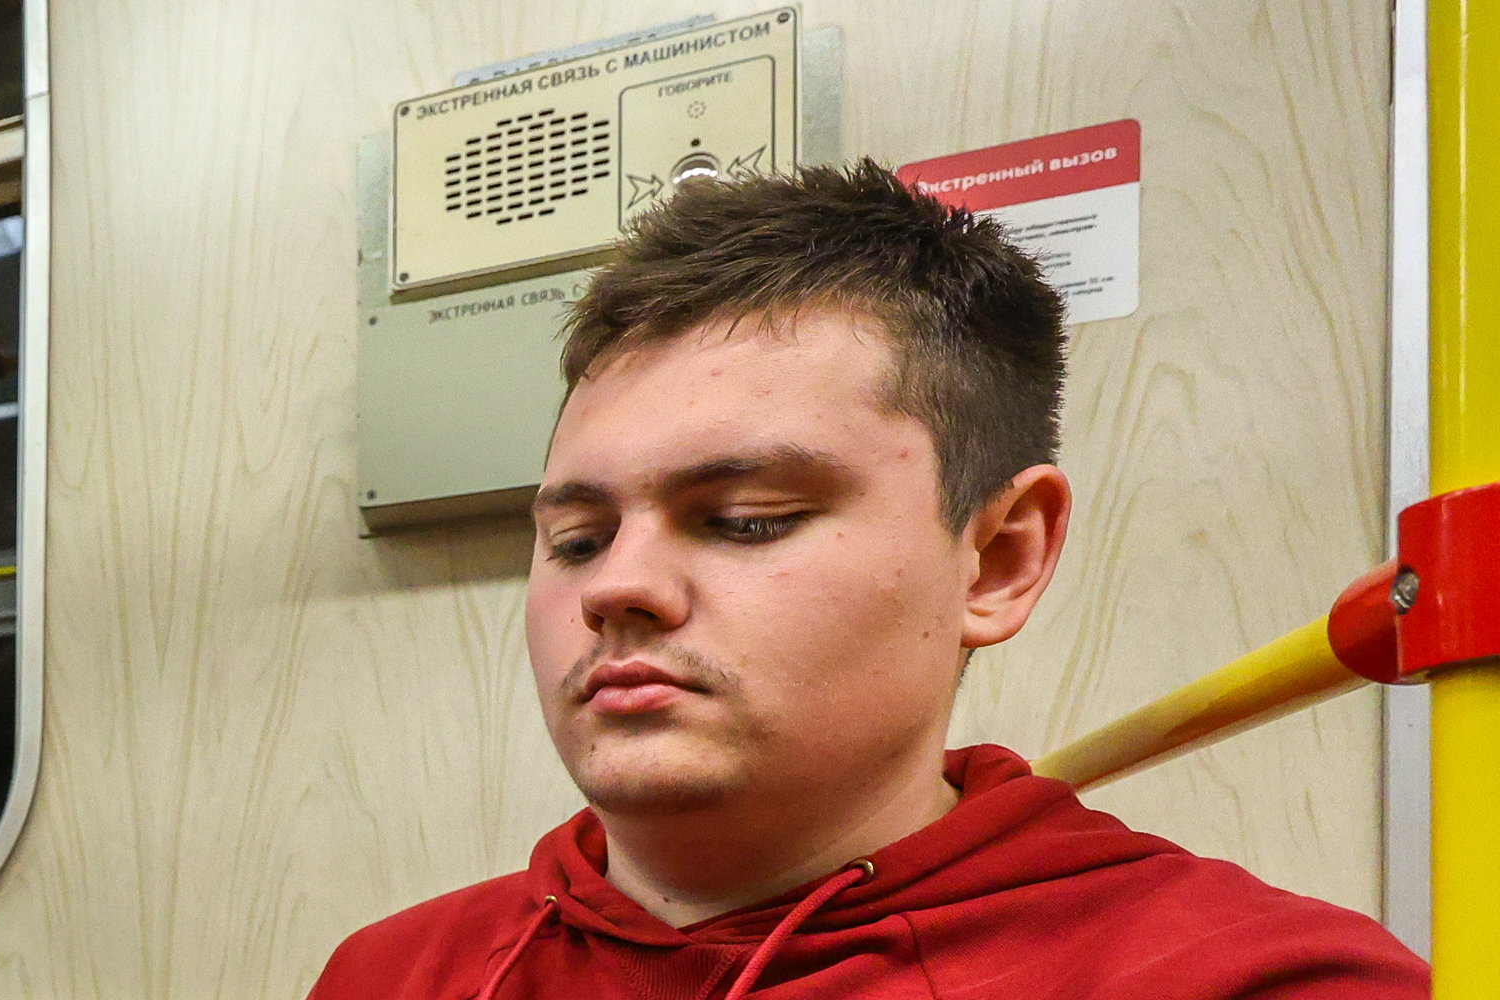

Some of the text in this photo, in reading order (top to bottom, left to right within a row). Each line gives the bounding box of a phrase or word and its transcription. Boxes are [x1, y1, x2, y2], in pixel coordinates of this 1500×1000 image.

[415, 21, 772, 121] ЭКСТРЕННАЯ СВЯЗЬ С МАШИНИСТОМ
[657, 70, 734, 99] ГОВОРИТЕ
[916, 147, 1119, 195] Экстренный вызов
[520, 287, 567, 306] СВЯЗЬ
